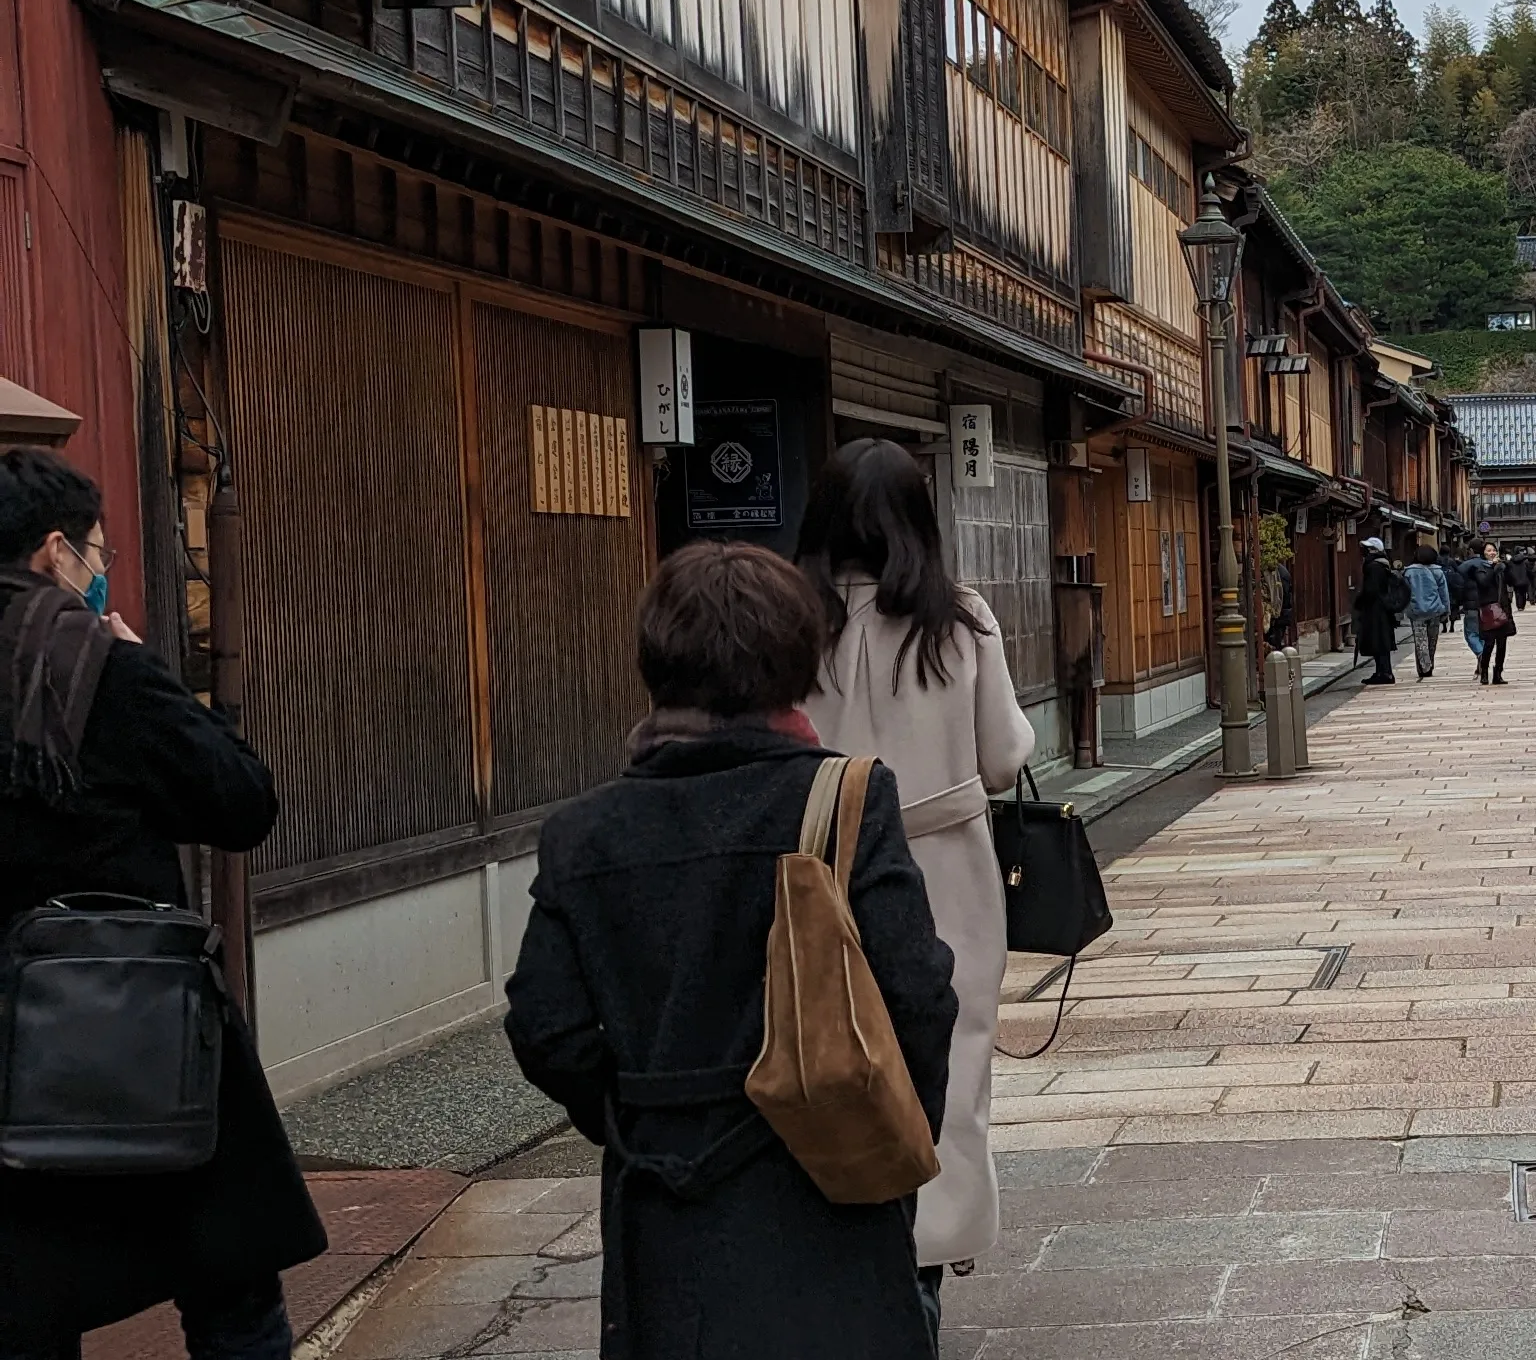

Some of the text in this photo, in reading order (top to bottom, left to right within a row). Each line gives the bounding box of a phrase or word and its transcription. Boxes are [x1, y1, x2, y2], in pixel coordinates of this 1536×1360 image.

[657, 384, 671, 435] ひがし
[962, 414, 979, 478] 宿陽月
